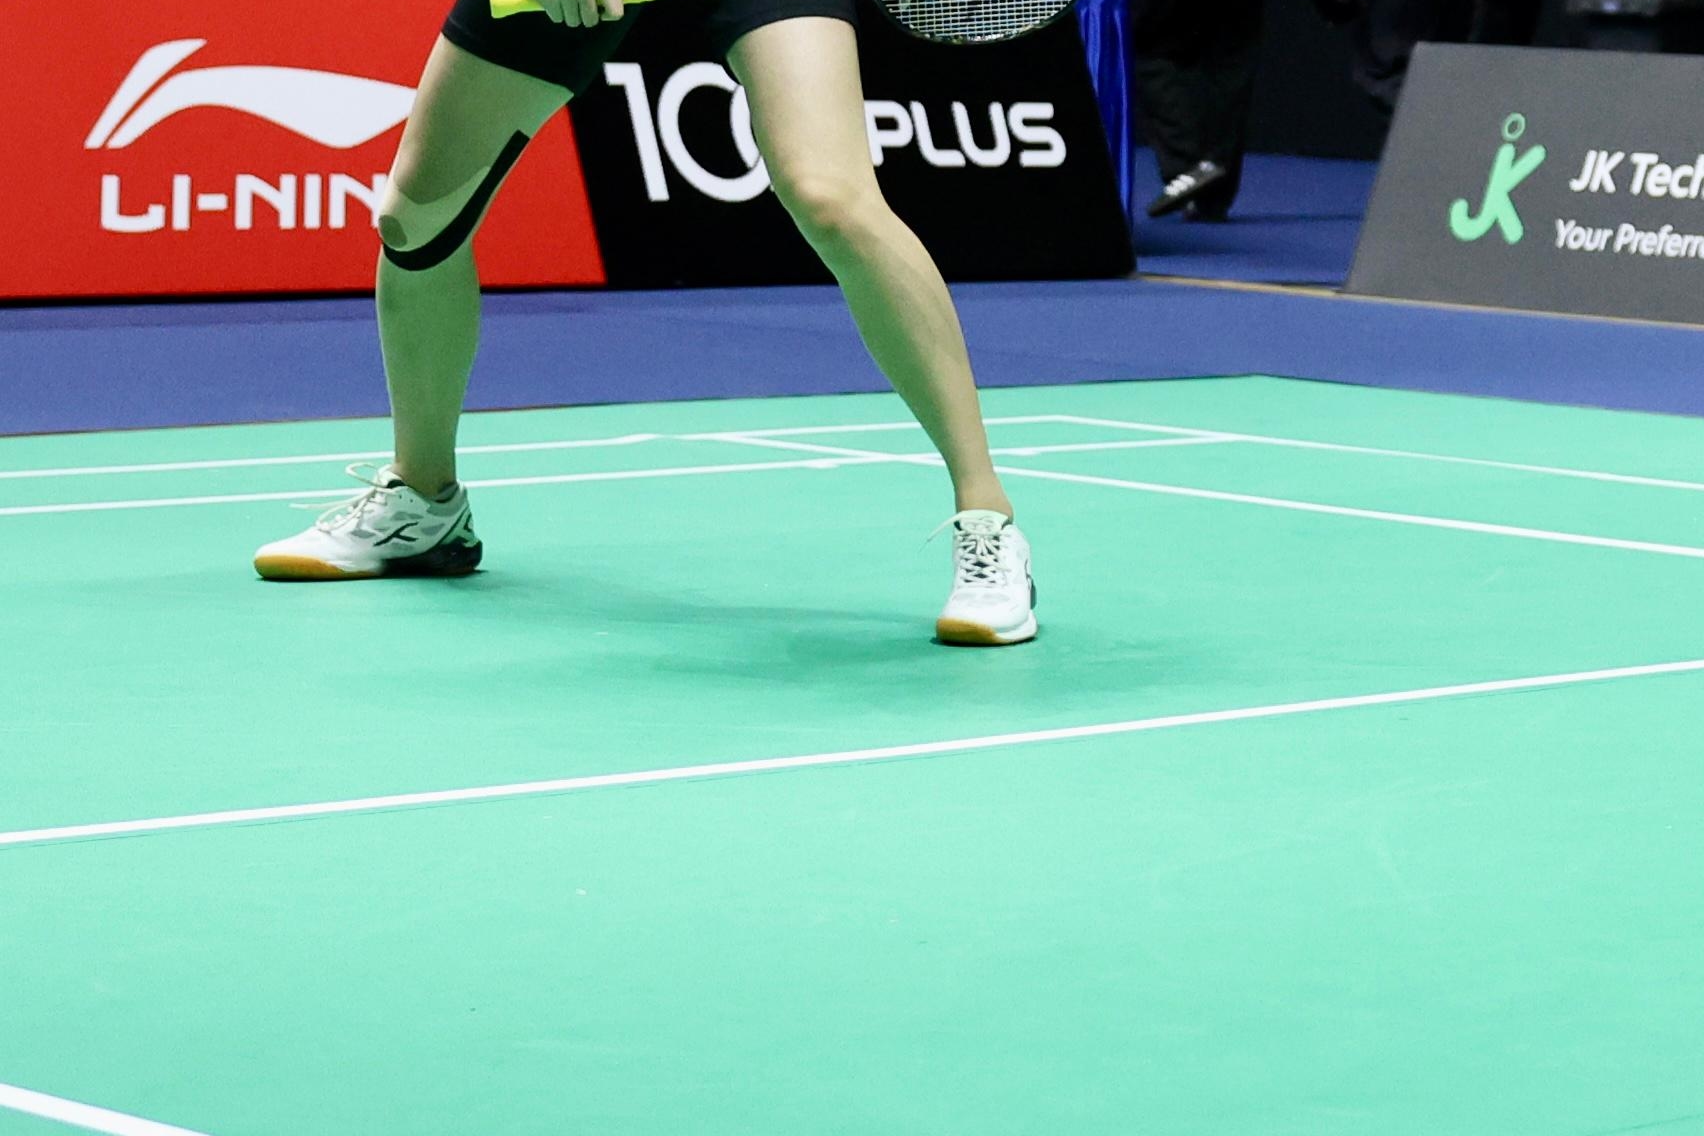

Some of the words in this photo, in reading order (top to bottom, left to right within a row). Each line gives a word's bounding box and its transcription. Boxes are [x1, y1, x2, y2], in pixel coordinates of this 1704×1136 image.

[864, 99, 1068, 168] PLUS
[1569, 149, 1625, 194] JK
[100, 173, 388, 233] LI-NIN
[1554, 218, 1613, 253] Your
